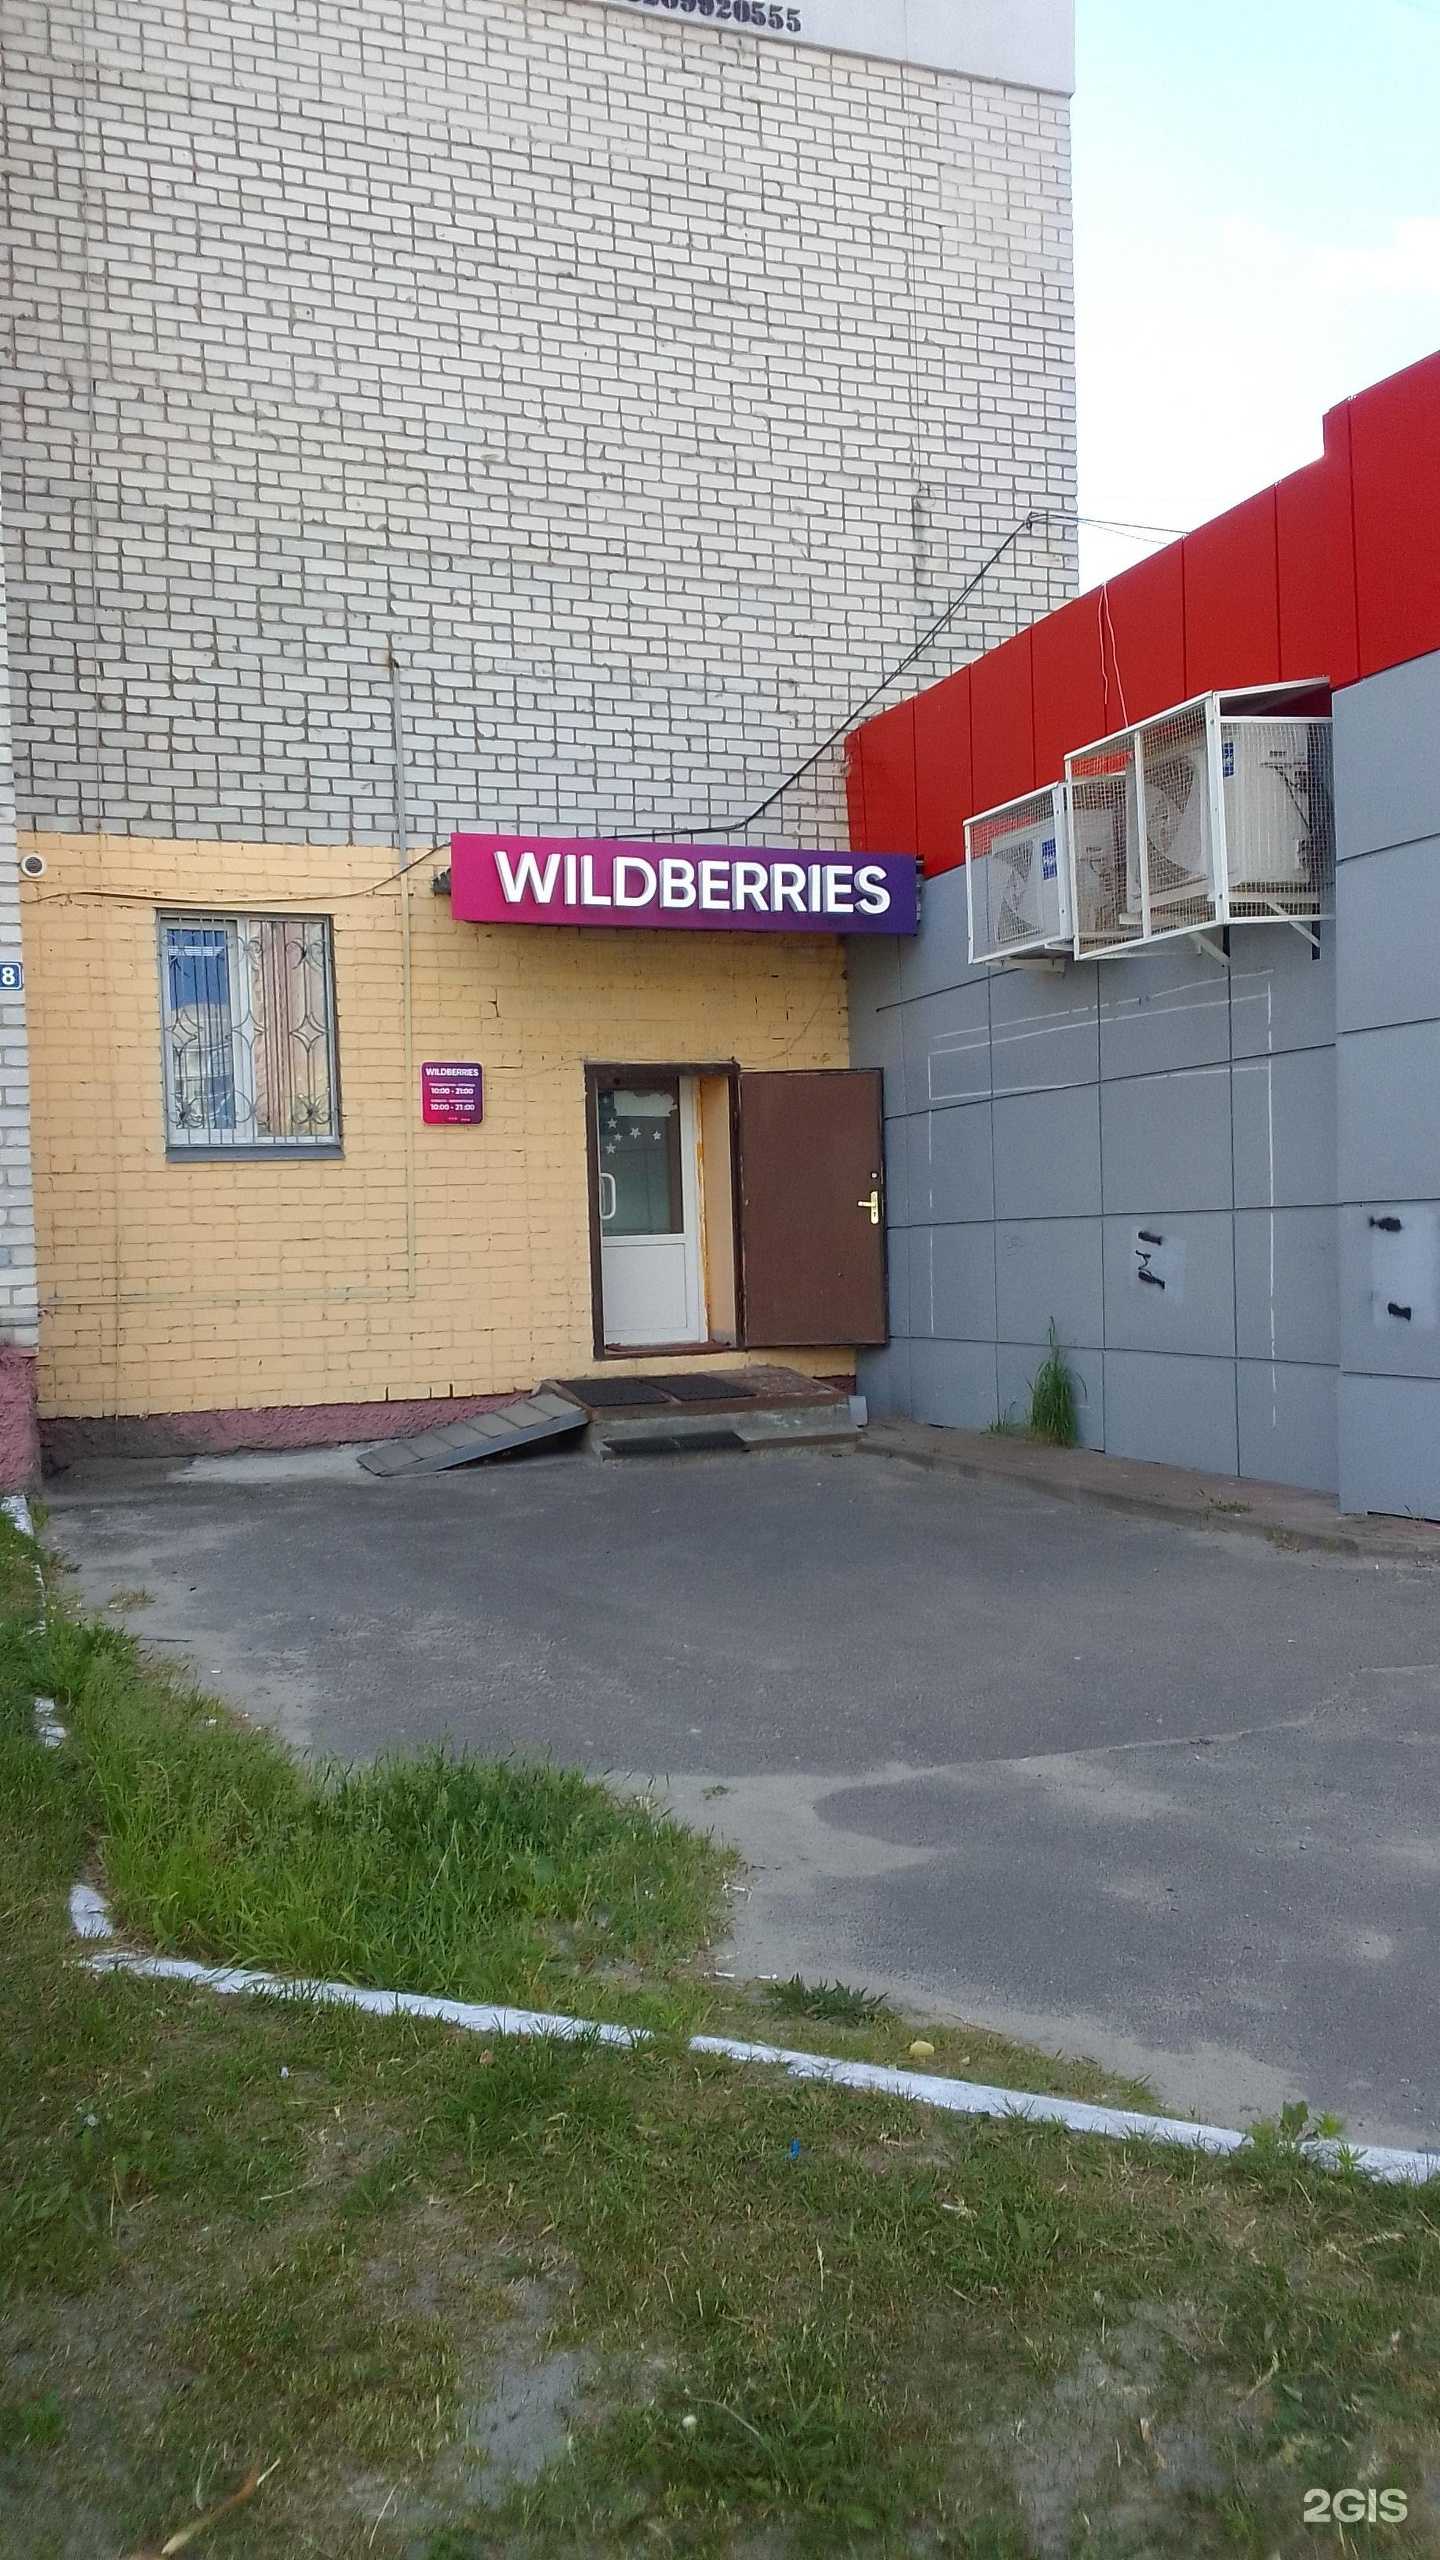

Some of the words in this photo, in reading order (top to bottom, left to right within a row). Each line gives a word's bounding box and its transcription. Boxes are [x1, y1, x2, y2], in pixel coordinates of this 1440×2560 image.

[494, 851, 892, 915] WILDBERRIES
[2, 966, 16, 986] 8
[425, 1068, 479, 1076] WILDBERRIES
